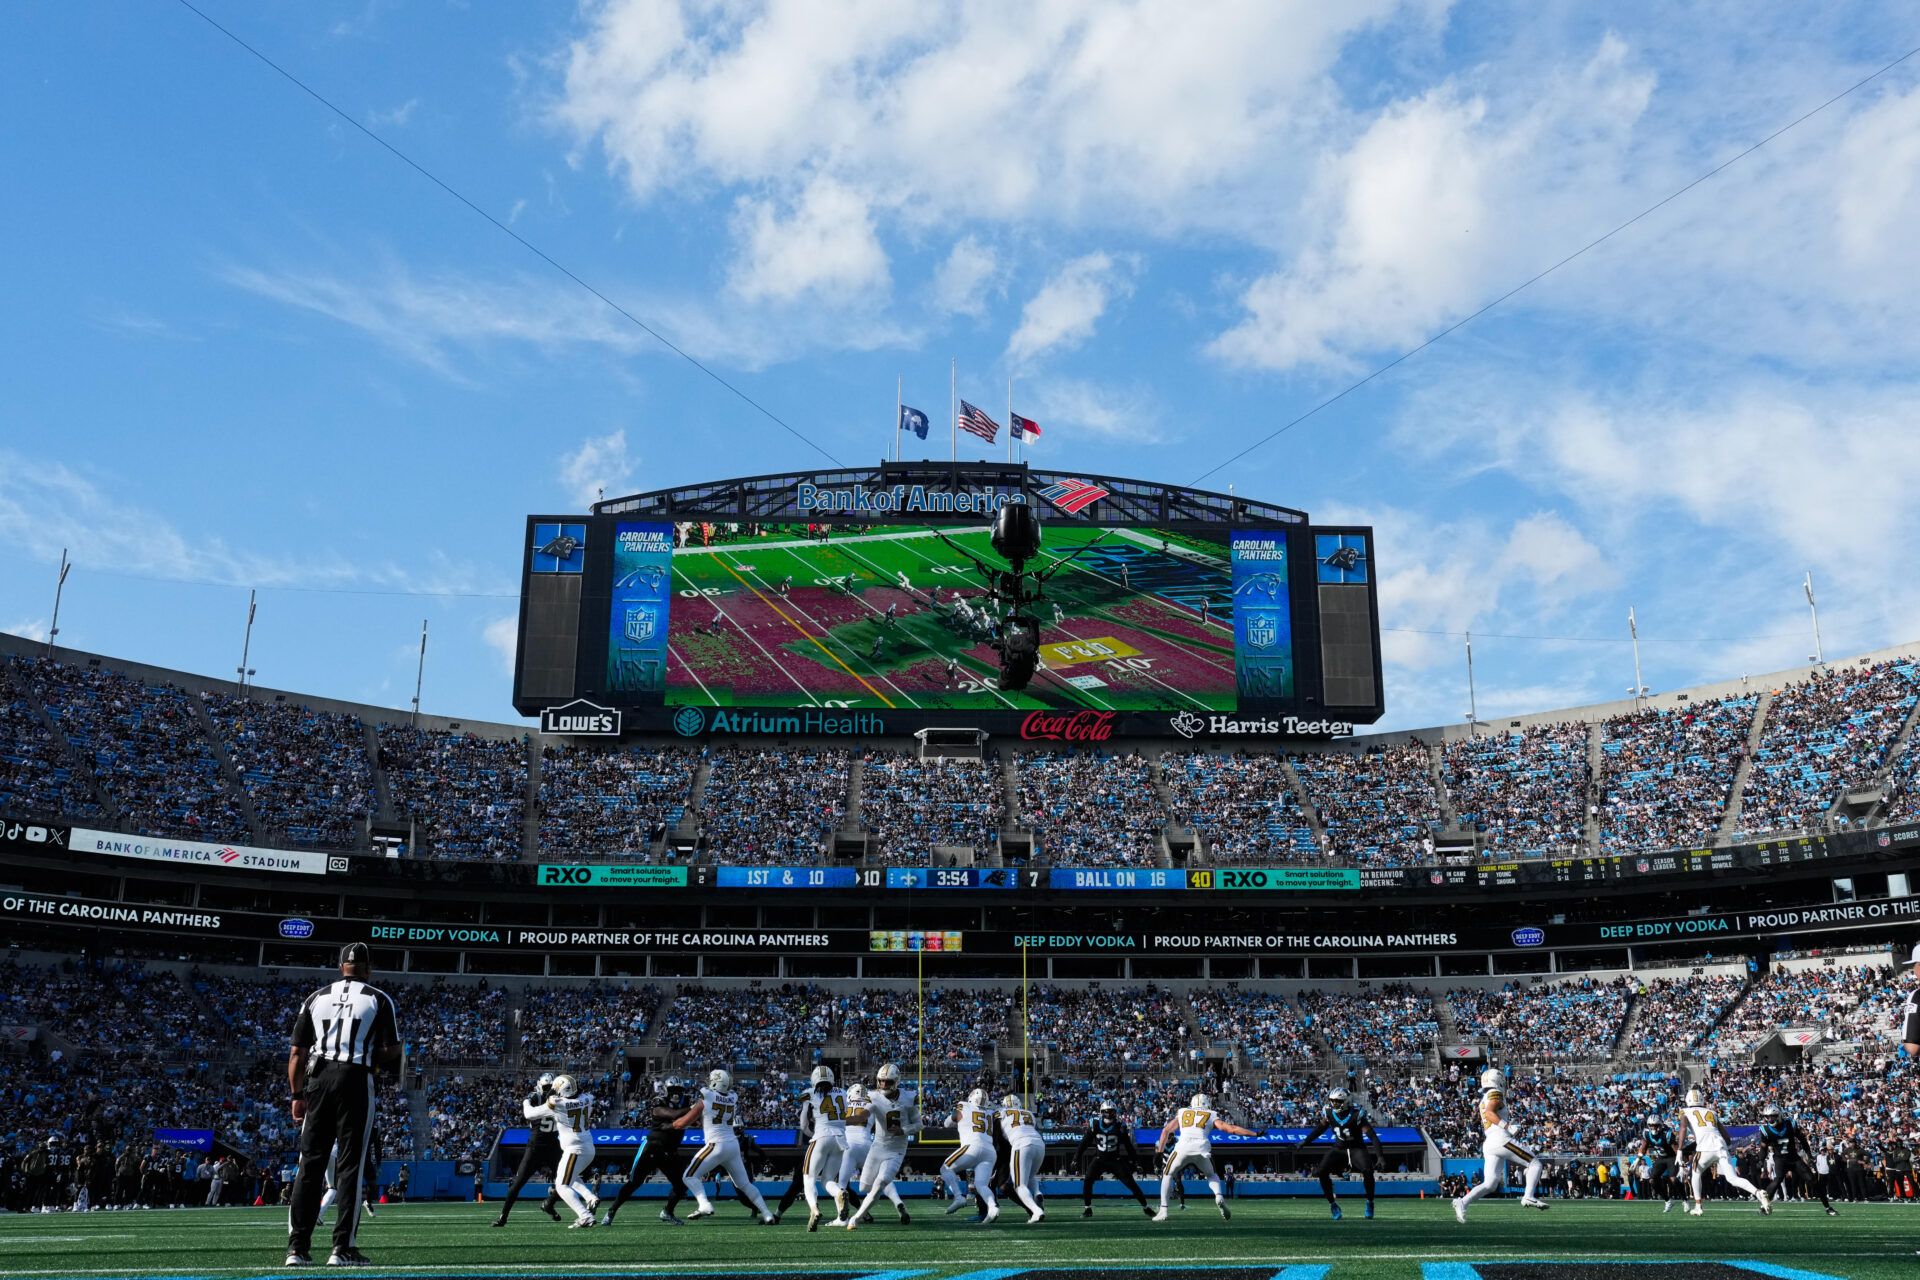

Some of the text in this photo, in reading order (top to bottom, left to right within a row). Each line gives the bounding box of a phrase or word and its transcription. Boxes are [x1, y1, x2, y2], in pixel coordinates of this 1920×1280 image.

[797, 483, 871, 511] Bank
[873, 485, 905, 512] of
[619, 531, 664, 542] CAROLINA
[623, 541, 671, 552] PANTHERS
[1232, 540, 1276, 550] CAROLINA
[1238, 549, 1283, 560] PANTHERS
[629, 622, 651, 637] NFL
[1251, 629, 1273, 643] NFL
[548, 713, 613, 732] LOWE'S
[710, 710, 884, 734] Atrium Health
[1209, 715, 1353, 736] Harris Teeter
[1893, 830, 1919, 842] SCORES
[96, 840, 300, 868] BANK OF AMERICA STADIUM
[1653, 857, 1674, 865] SEASON
[636, 867, 671, 875] solutions
[1371, 870, 1404, 878] BEHAVIOR
[1652, 863, 1676, 871] LEADERS
[545, 867, 592, 884] RXO
[633, 877, 651, 885] your
[652, 876, 680, 885] freight.
[698, 875, 705, 884] 2
[747, 869, 824, 885] 1ST & 10
[863, 870, 880, 886] 10
[937, 871, 969, 886] 3:54
[1029, 871, 1039, 887] 7
[1075, 871, 1166, 887] BALL ON 16
[1191, 871, 1211, 888] 40
[1223, 871, 1267, 887] RXO
[1308, 880, 1326, 888] your
[1326, 879, 1353, 888] freight.
[3, 897, 221, 928] OF THE CAROLINA PANTHERS
[1749, 900, 1920, 928] PROUD PARTNER OF THE
[371, 926, 829, 946] DEEP EDDY VODKA PROUD PARTNER OF THE CAROLINA PANTHERS
[1600, 918, 1728, 939] DEEP EDDY VODKA
[1014, 933, 1458, 947] DEEP EDDY VODKA PROUD PARTNER OF THE CAROLINA PANTHERS
[340, 994, 349, 1003] U
[332, 1003, 354, 1018] 71
[820, 1095, 847, 1120] 41
[567, 1107, 589, 1132] 71
[886, 1110, 901, 1137] 6
[972, 1111, 993, 1134] 51
[1181, 1110, 1212, 1129] 87
[1693, 1110, 1718, 1127] 14
